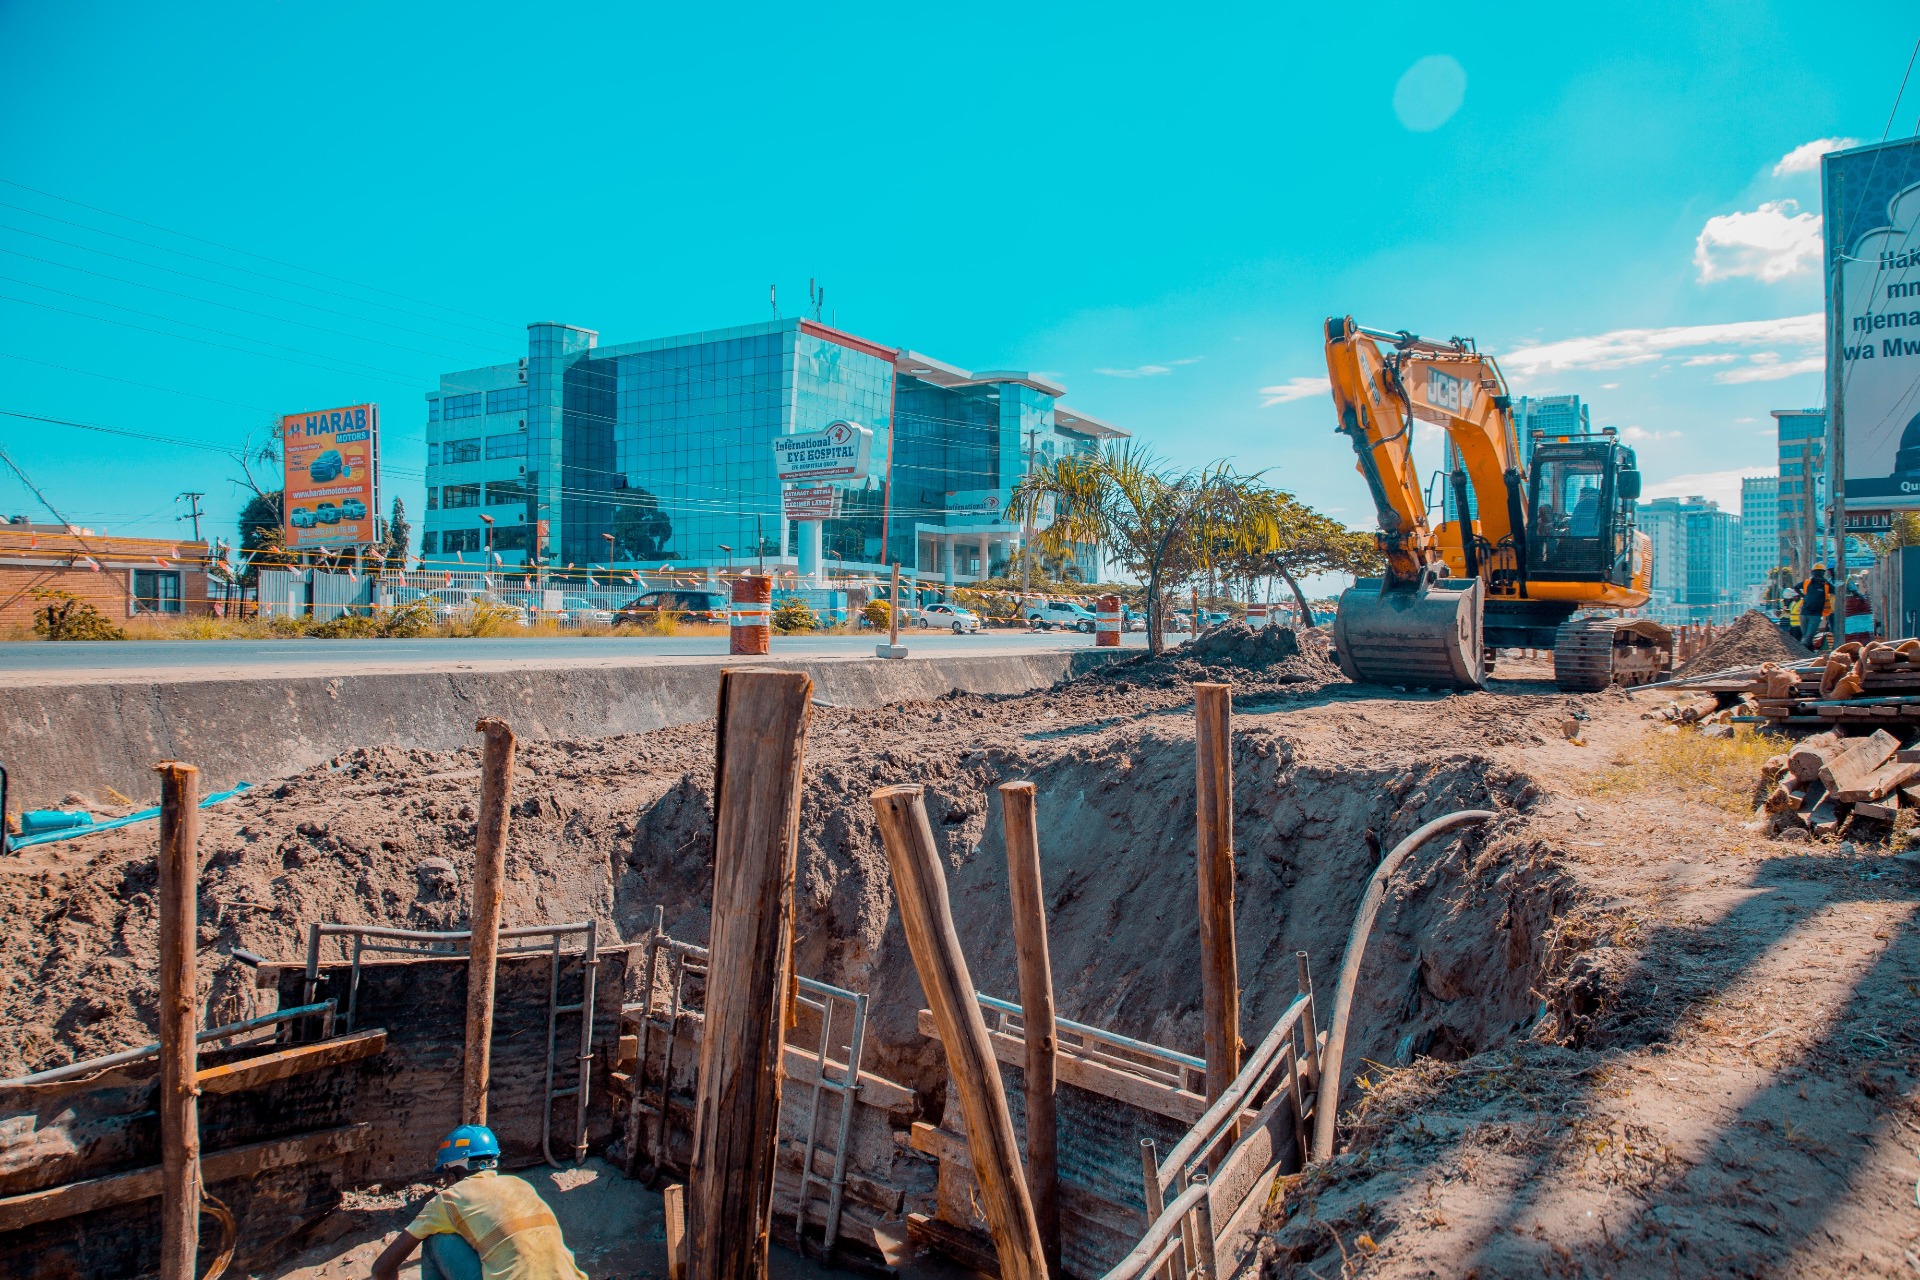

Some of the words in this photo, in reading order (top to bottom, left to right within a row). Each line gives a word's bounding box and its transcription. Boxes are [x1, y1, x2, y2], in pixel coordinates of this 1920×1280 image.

[1853, 310, 1920, 335] njema
[1427, 369, 1459, 411] JCB
[305, 408, 367, 437] HARAB
[336, 431, 367, 443] MOTORS
[775, 436, 831, 452] International
[787, 451, 806, 463] EYE
[808, 446, 854, 461] HOSPITAL
[292, 485, 363, 499] www.harabmotors.com
[1901, 481, 1920, 493] Qu
